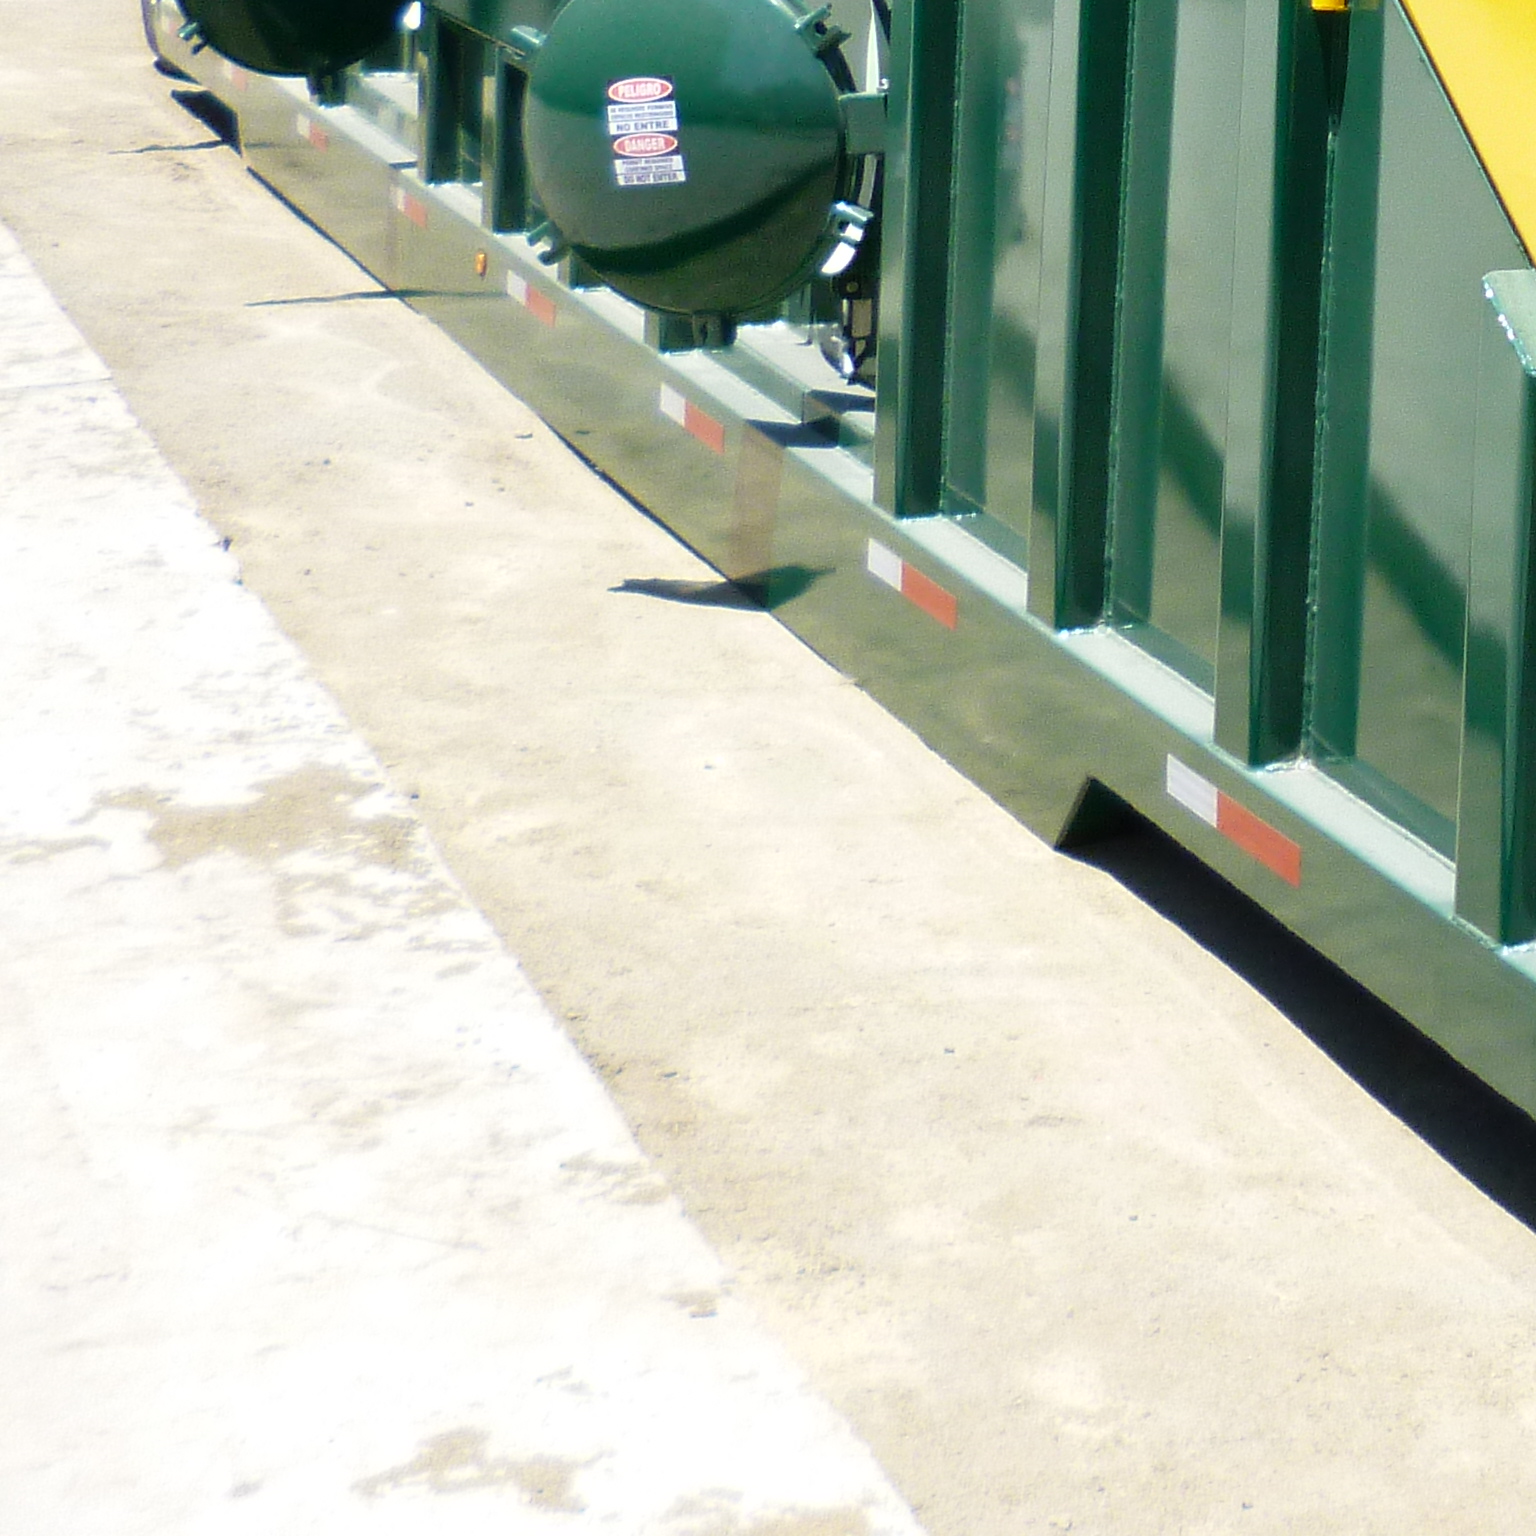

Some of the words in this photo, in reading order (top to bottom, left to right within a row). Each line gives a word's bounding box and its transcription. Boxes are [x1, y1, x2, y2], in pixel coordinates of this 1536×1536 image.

[617, 82, 662, 98] PELIGRO
[616, 123, 631, 132] NO
[634, 120, 669, 131] ENTRE
[624, 137, 666, 153] DANGER
